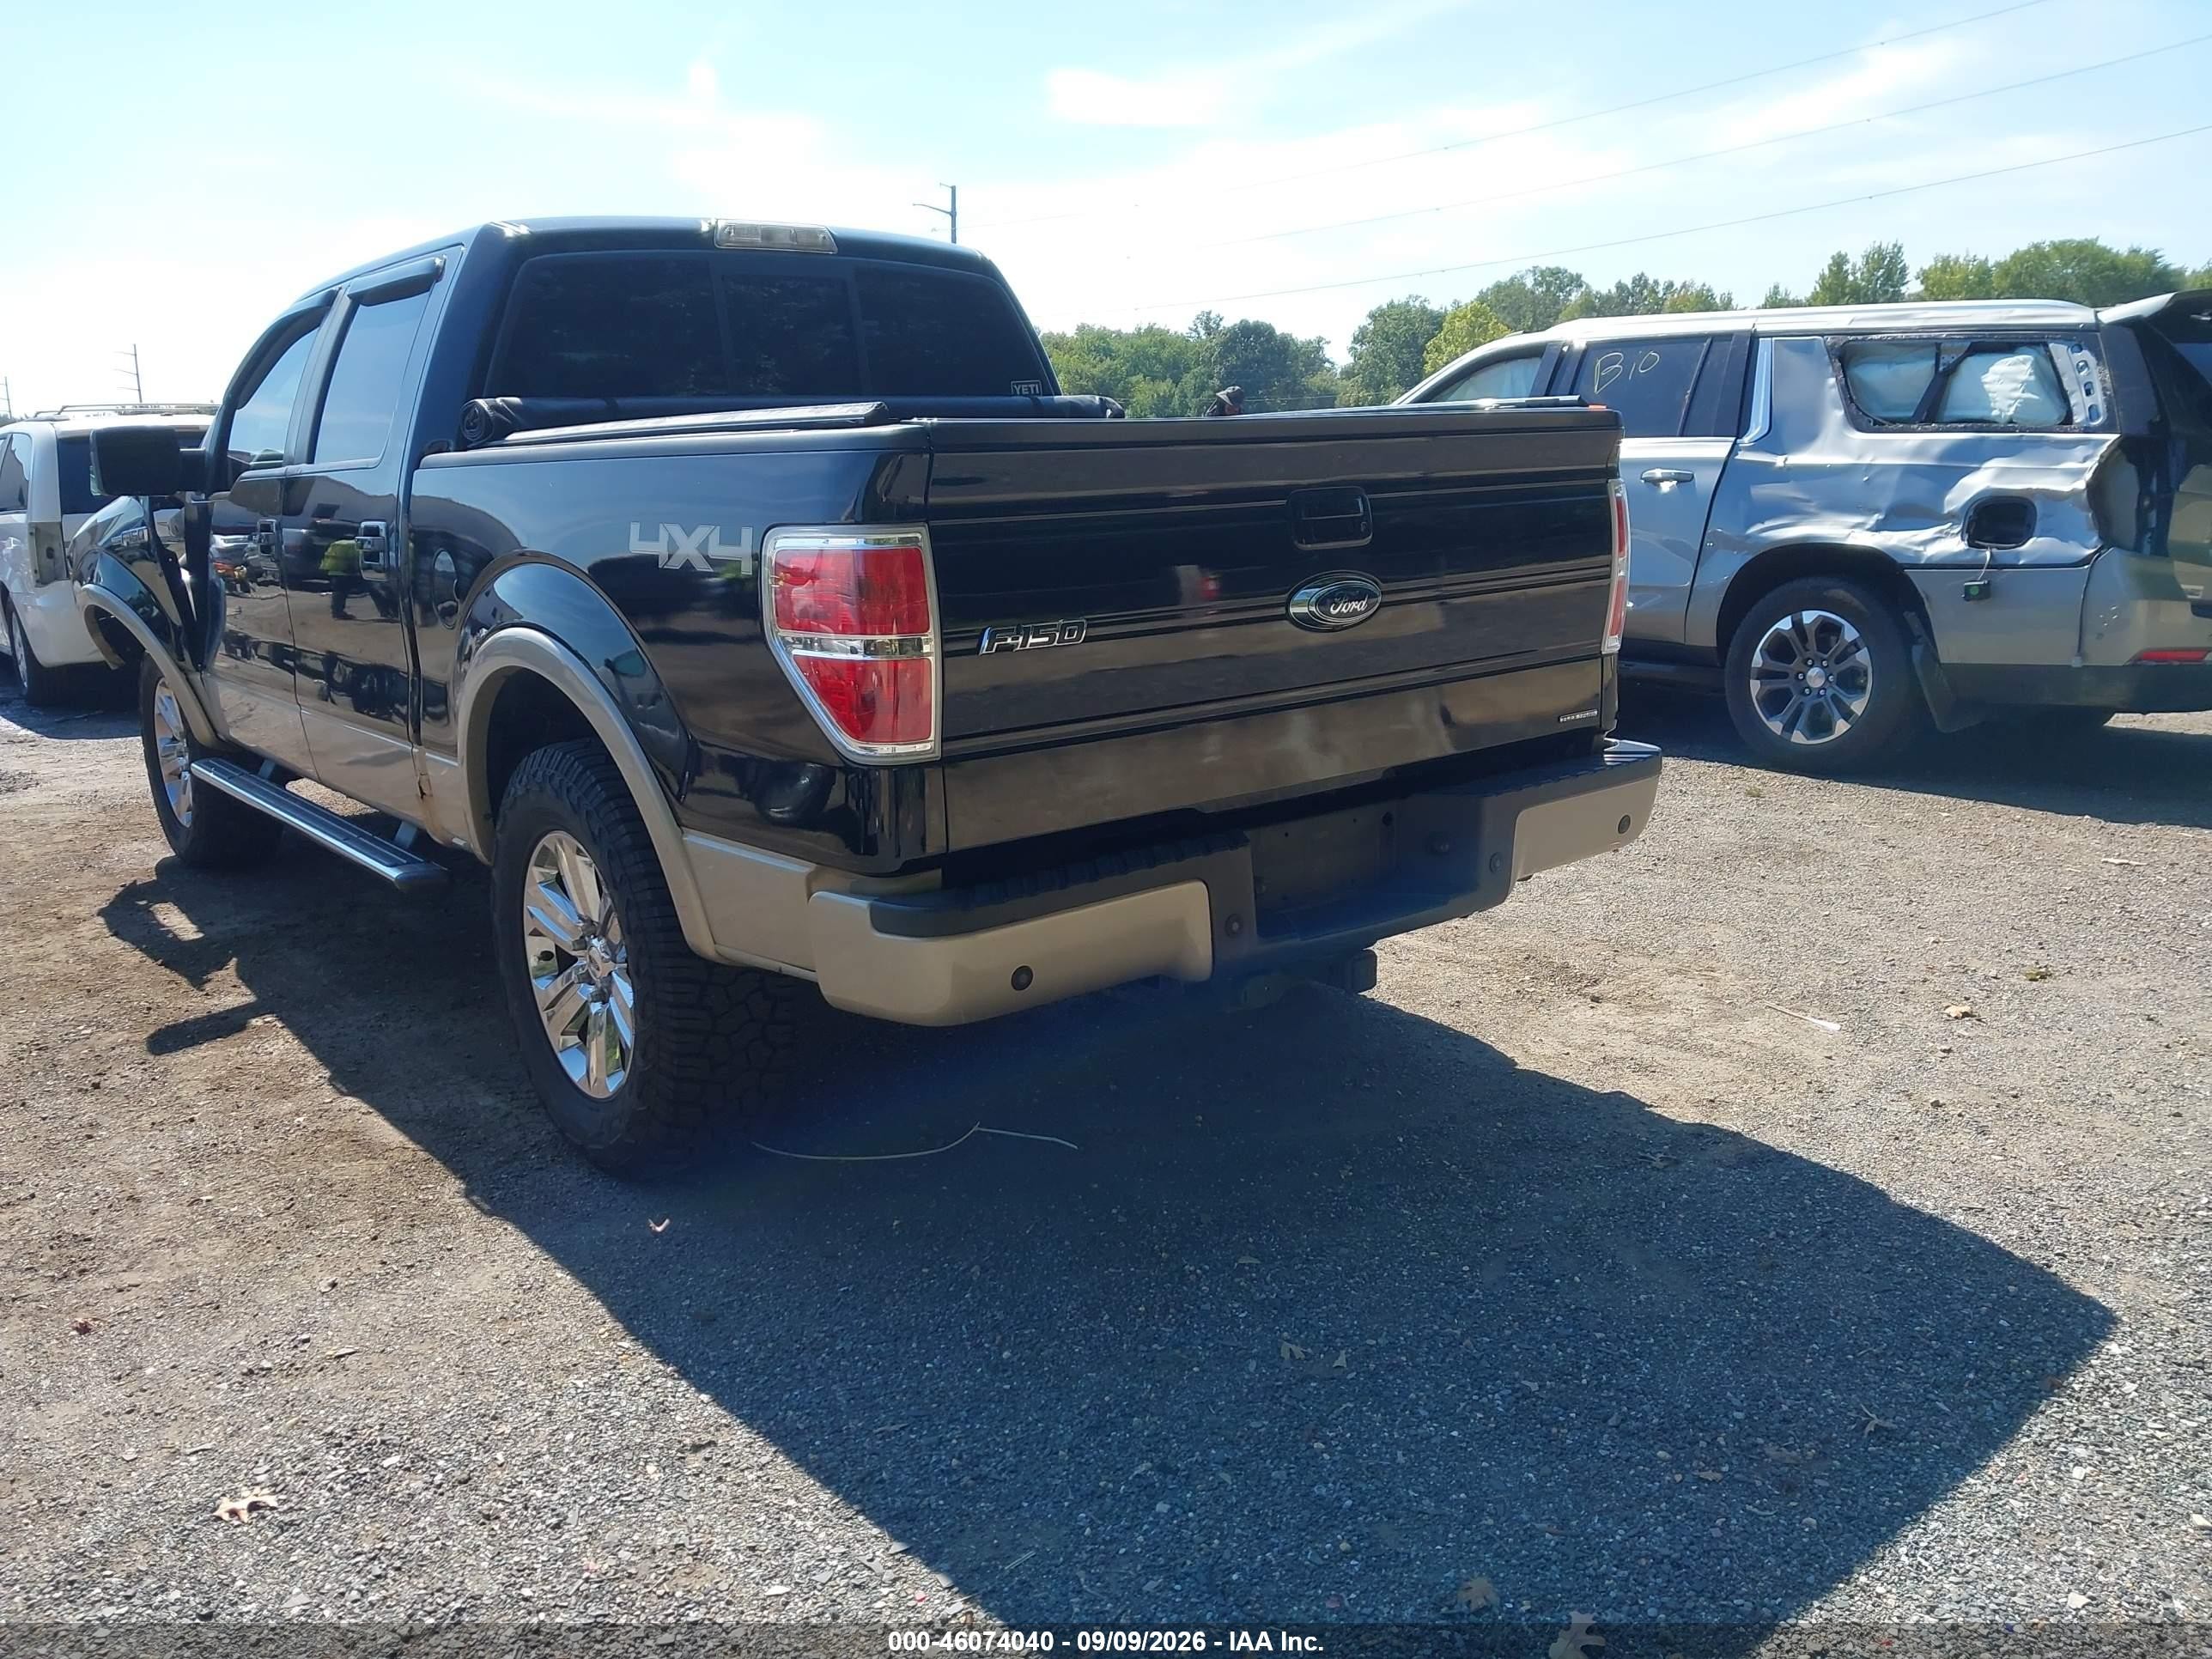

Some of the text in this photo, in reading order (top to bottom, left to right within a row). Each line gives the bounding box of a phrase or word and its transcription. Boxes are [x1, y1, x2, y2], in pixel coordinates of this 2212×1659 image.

[1013, 384, 1039, 395] YETI
[1330, 593, 1369, 615] Ford
[979, 618, 1088, 655] F-150
